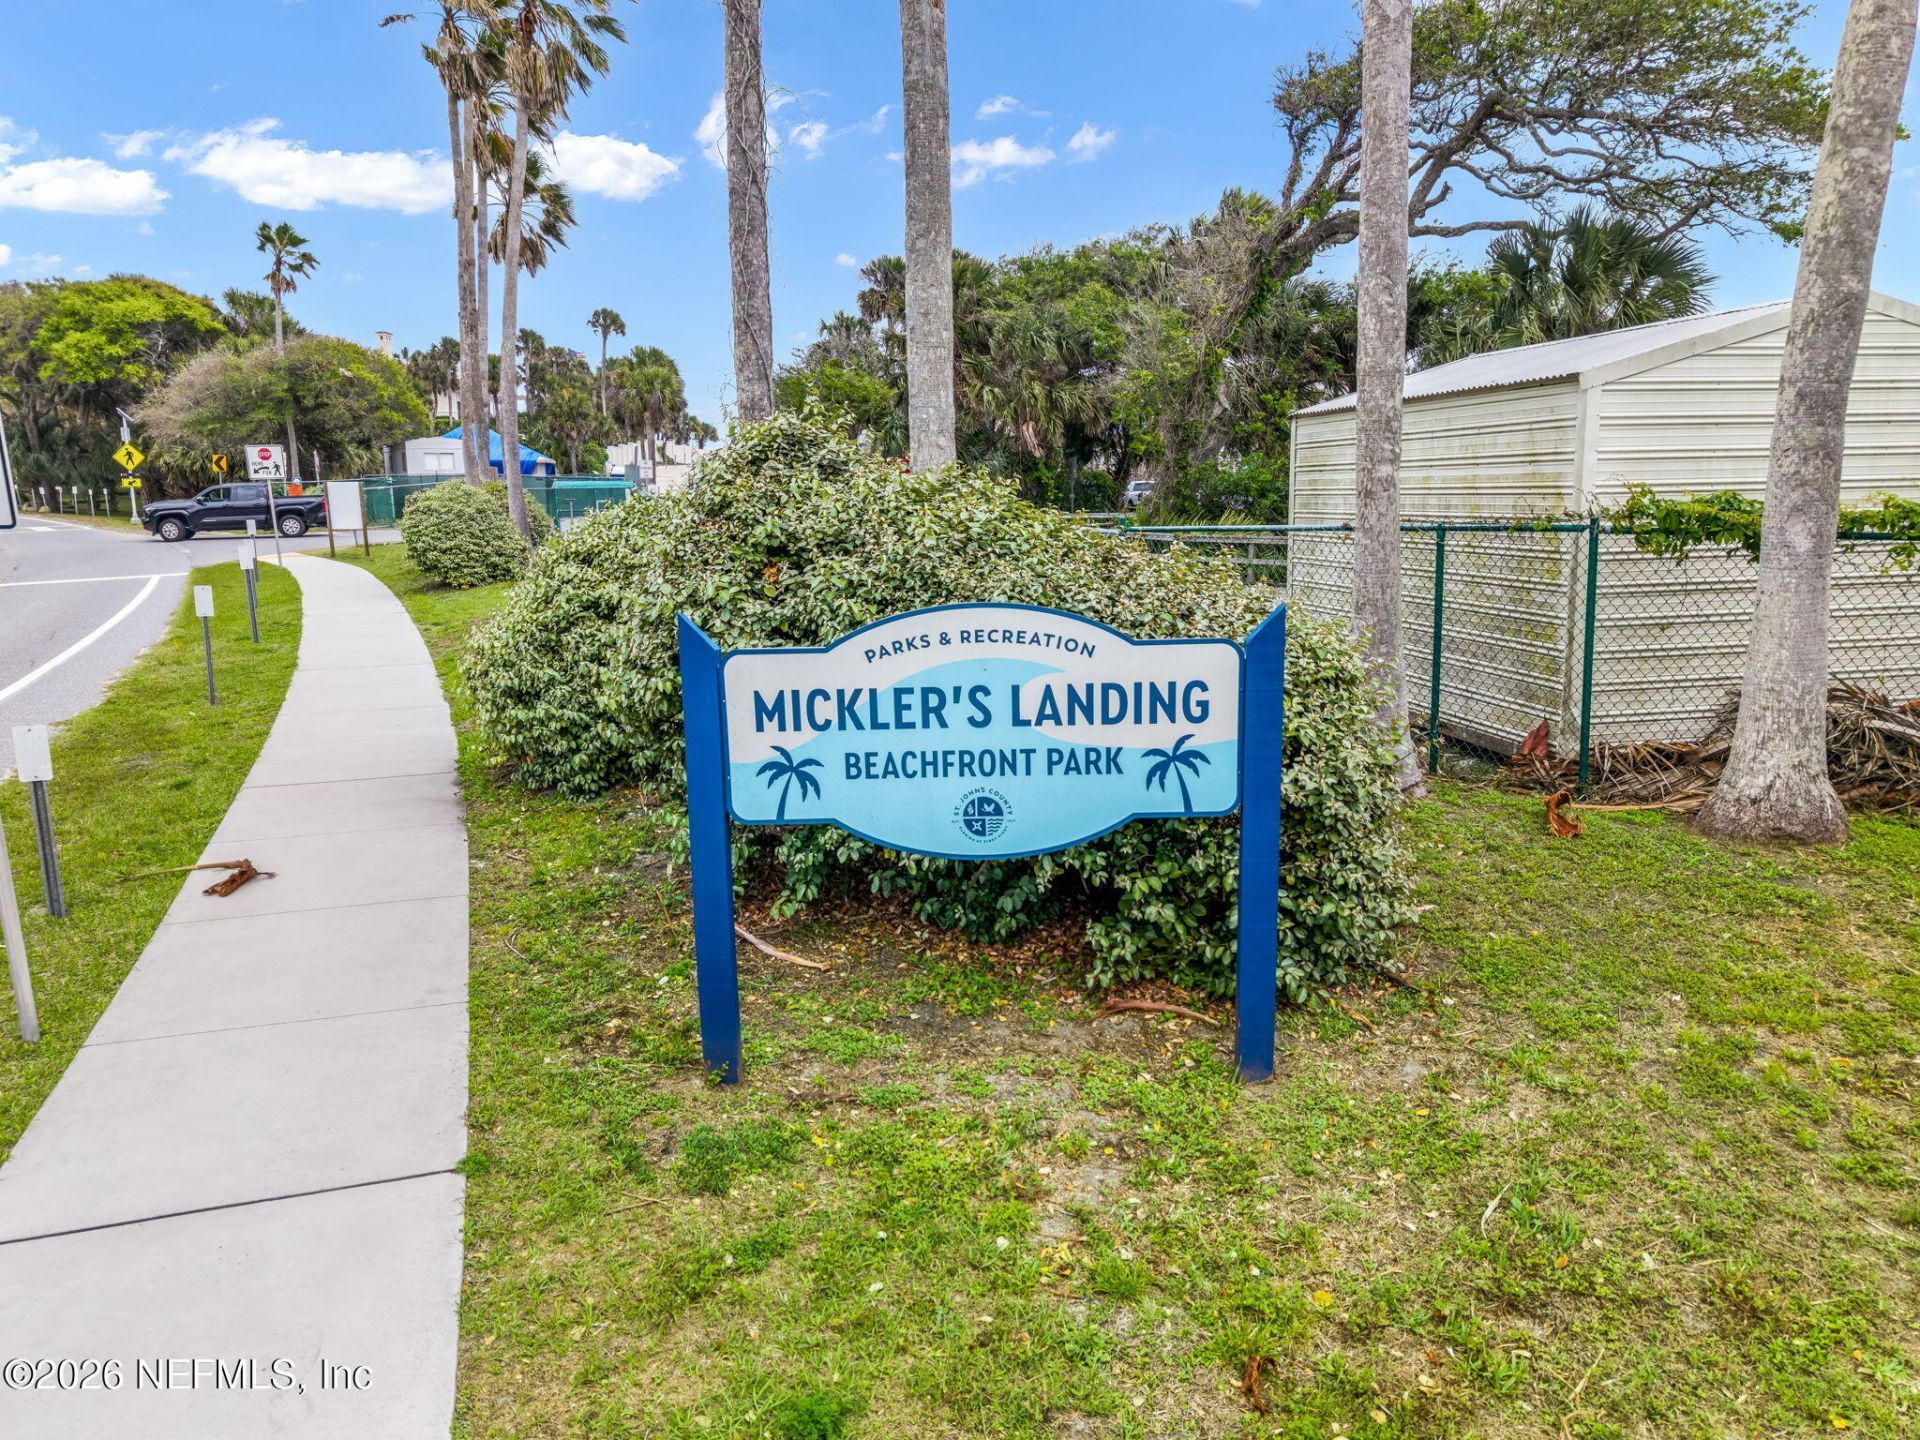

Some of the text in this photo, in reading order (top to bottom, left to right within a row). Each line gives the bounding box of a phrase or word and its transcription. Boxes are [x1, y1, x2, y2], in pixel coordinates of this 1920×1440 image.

[864, 629, 1096, 664] PARKS & RECREATION
[752, 679, 1211, 733] MICKLER'S LANDING
[844, 746, 1124, 780] BEACHFRONT PARK
[953, 804, 962, 816] ST.
[988, 788, 1014, 816] COUNTY
